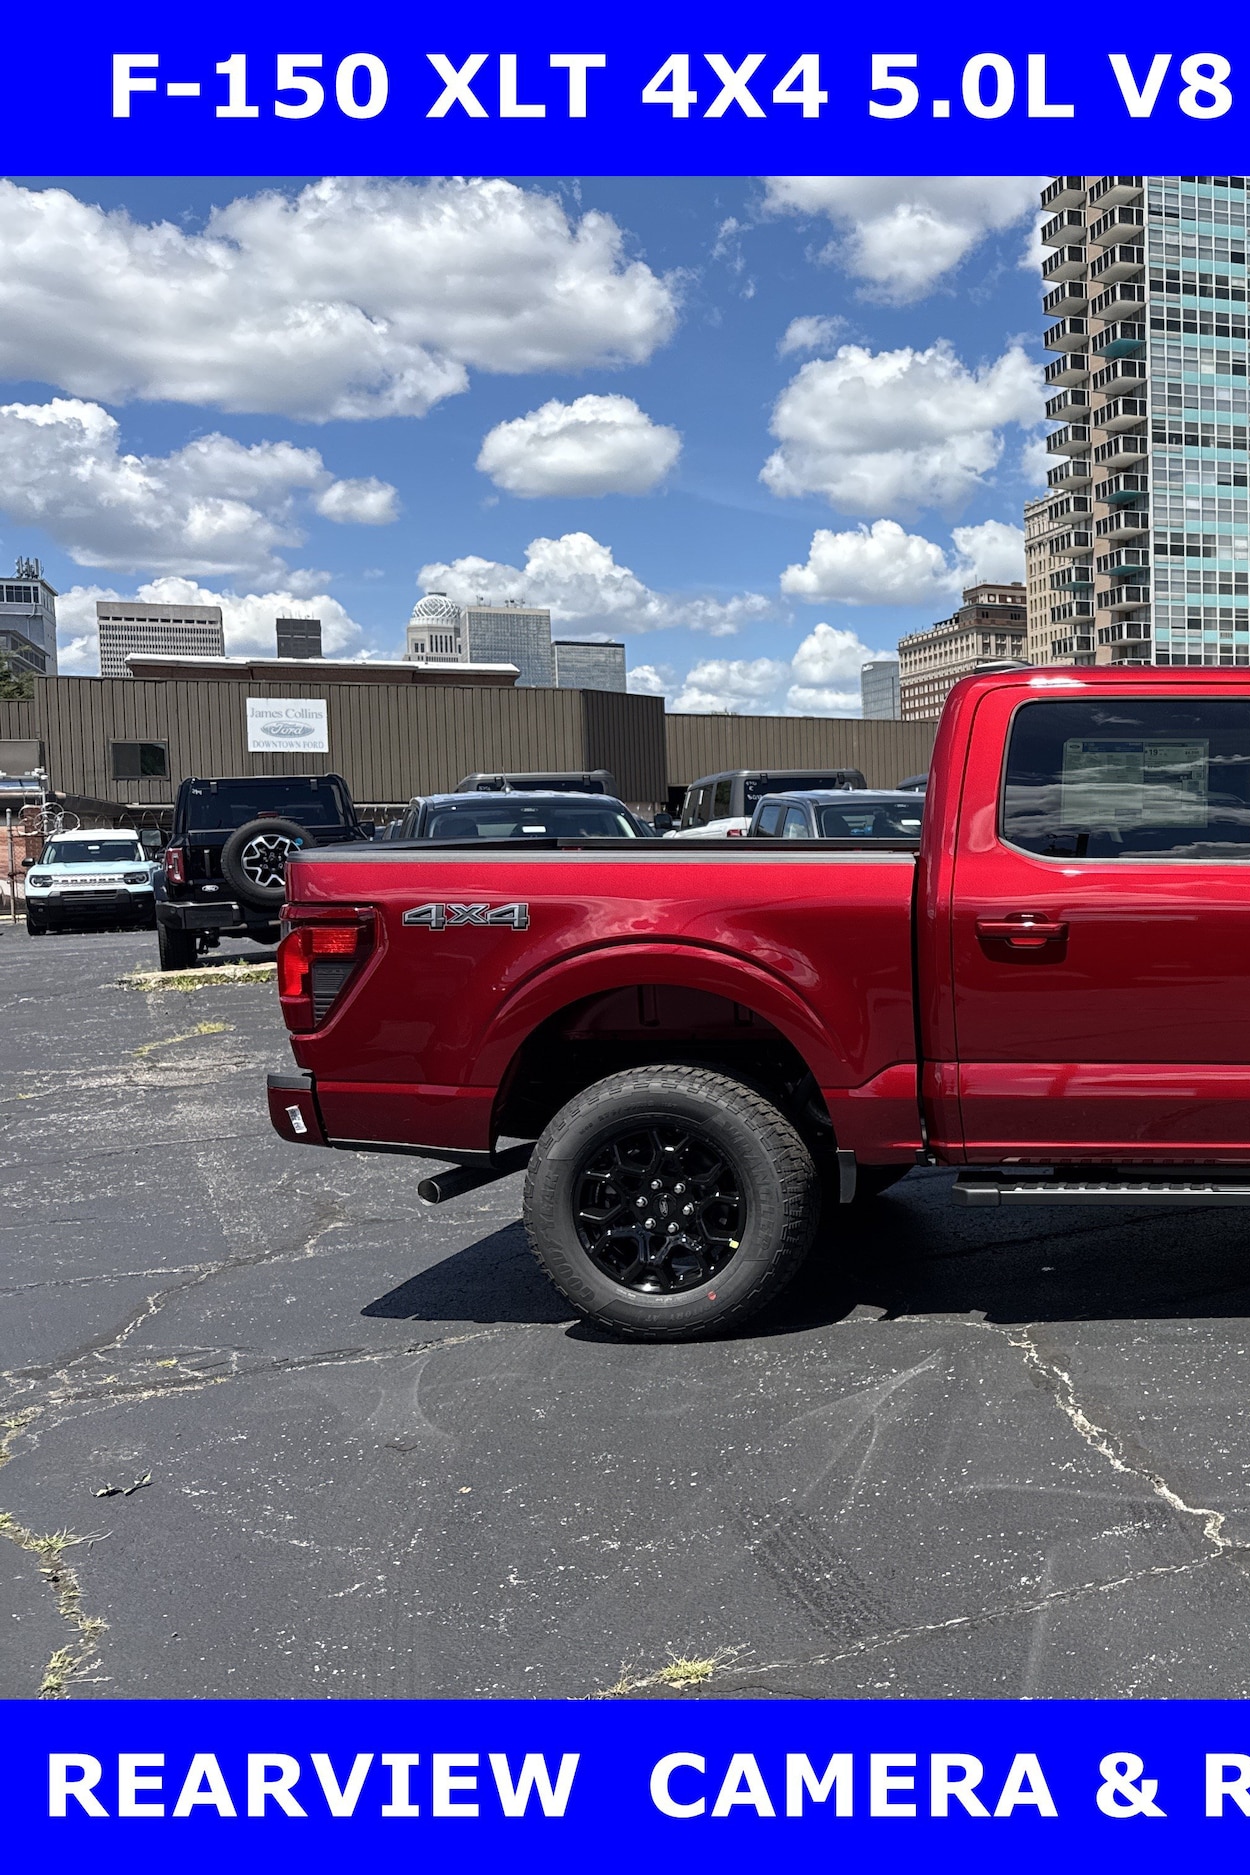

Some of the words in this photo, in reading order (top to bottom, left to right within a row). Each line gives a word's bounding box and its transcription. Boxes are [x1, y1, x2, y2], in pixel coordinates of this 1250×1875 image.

[250, 707, 283, 719] James
[285, 708, 324, 719] Collins
[252, 739, 302, 749] DOWNTOWN
[302, 740, 325, 749] FORD
[538, 1171, 598, 1304] GOODYEAR
